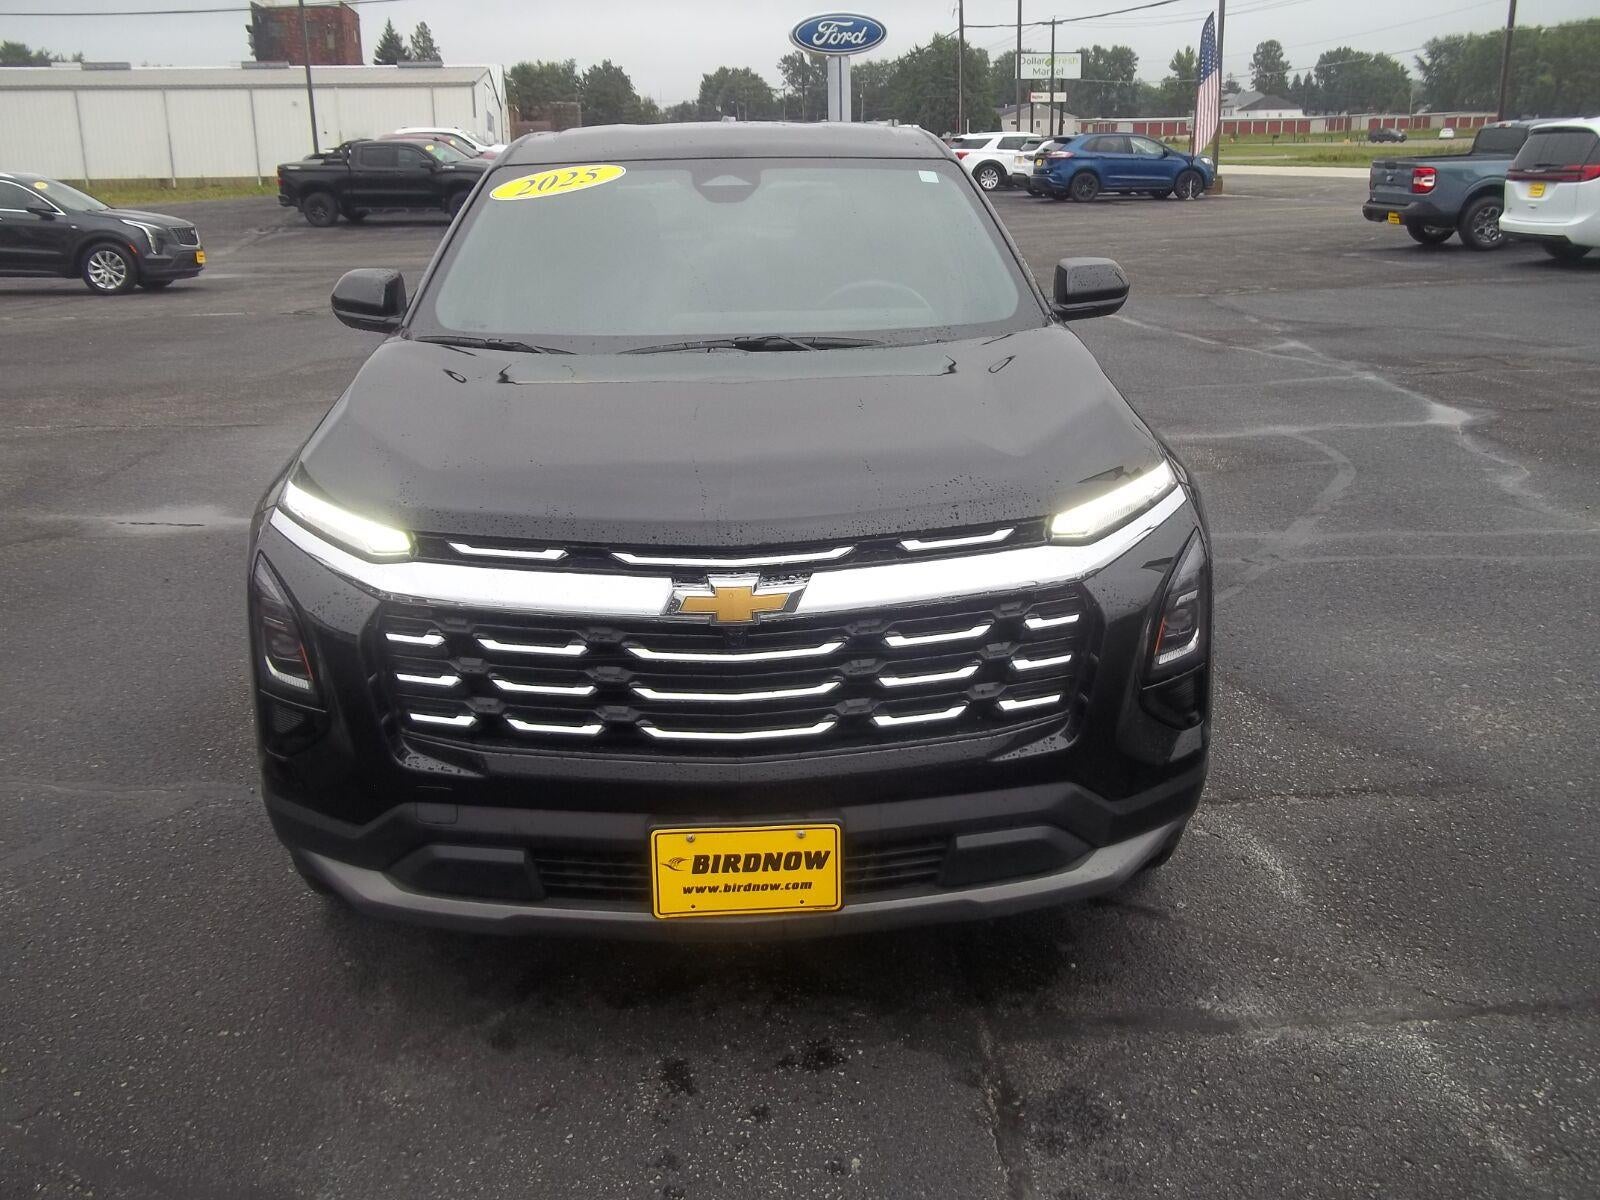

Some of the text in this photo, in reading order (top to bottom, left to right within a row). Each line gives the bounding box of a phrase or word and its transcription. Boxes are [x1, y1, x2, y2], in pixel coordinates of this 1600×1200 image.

[812, 20, 868, 46] Ford
[1032, 67, 1064, 76] Maret
[513, 167, 603, 196] 2025
[691, 850, 831, 875] BIRDNOW
[682, 881, 813, 895] www.birdnow.com
